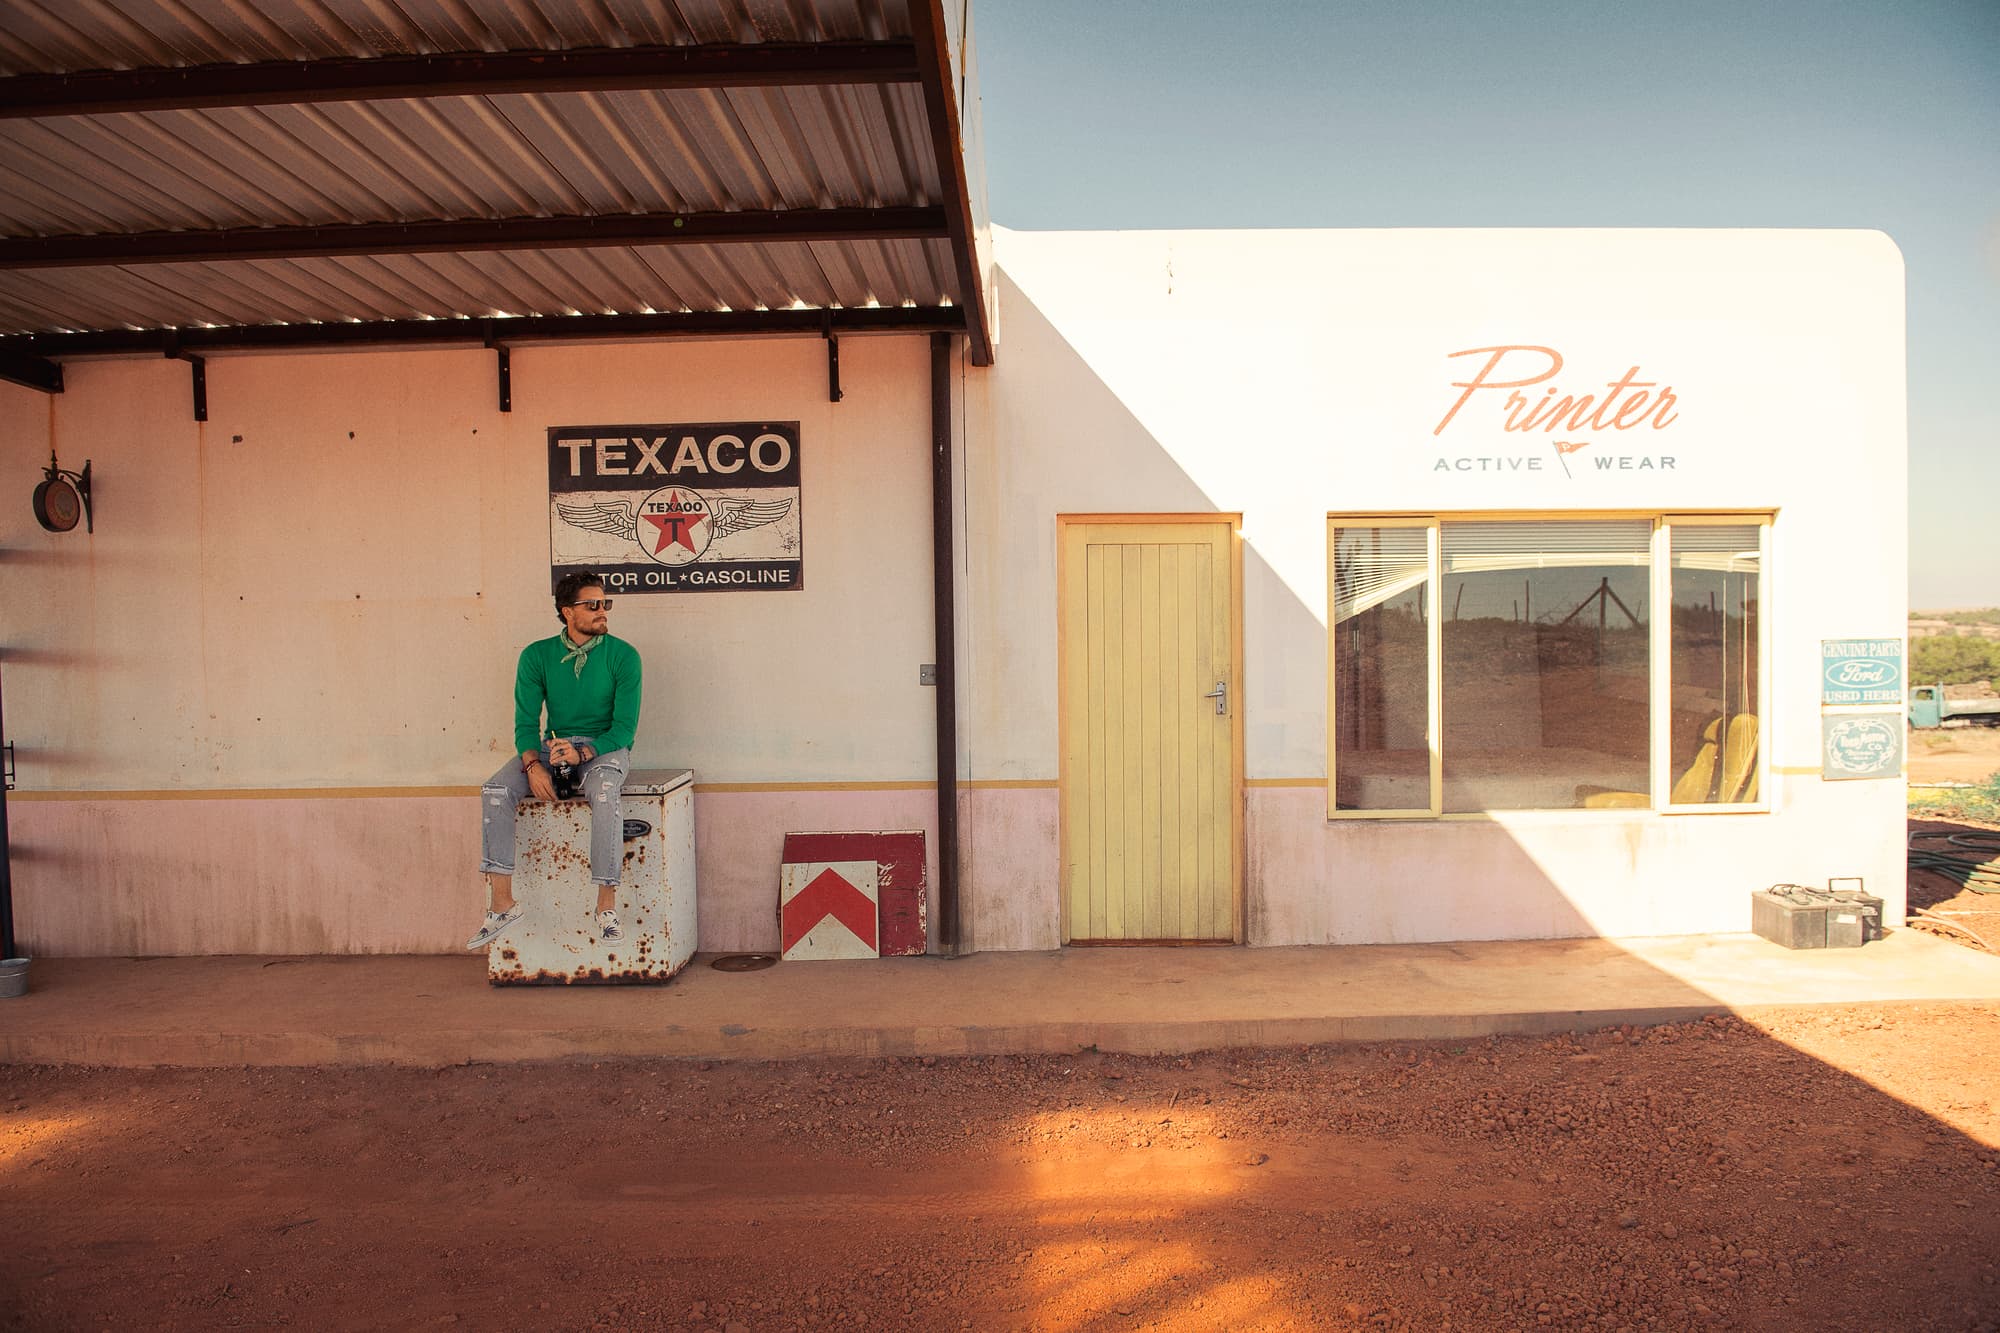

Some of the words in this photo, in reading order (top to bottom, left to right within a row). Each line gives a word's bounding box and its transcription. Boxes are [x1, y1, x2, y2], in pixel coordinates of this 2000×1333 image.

[1433, 345, 1679, 436] Printer
[558, 433, 792, 477] TEXACO
[1433, 457, 1543, 471] ACTIVE
[1594, 456, 1676, 470] WEAR
[663, 517, 685, 543] T
[645, 571, 677, 586] OIL
[689, 569, 790, 585] GASOLINE
[1823, 643, 1868, 657] GENUINE
[1869, 642, 1900, 656] PARTS
[1840, 662, 1884, 682] Ford
[1825, 690, 1861, 702] USED
[1863, 690, 1899, 701] HERE
